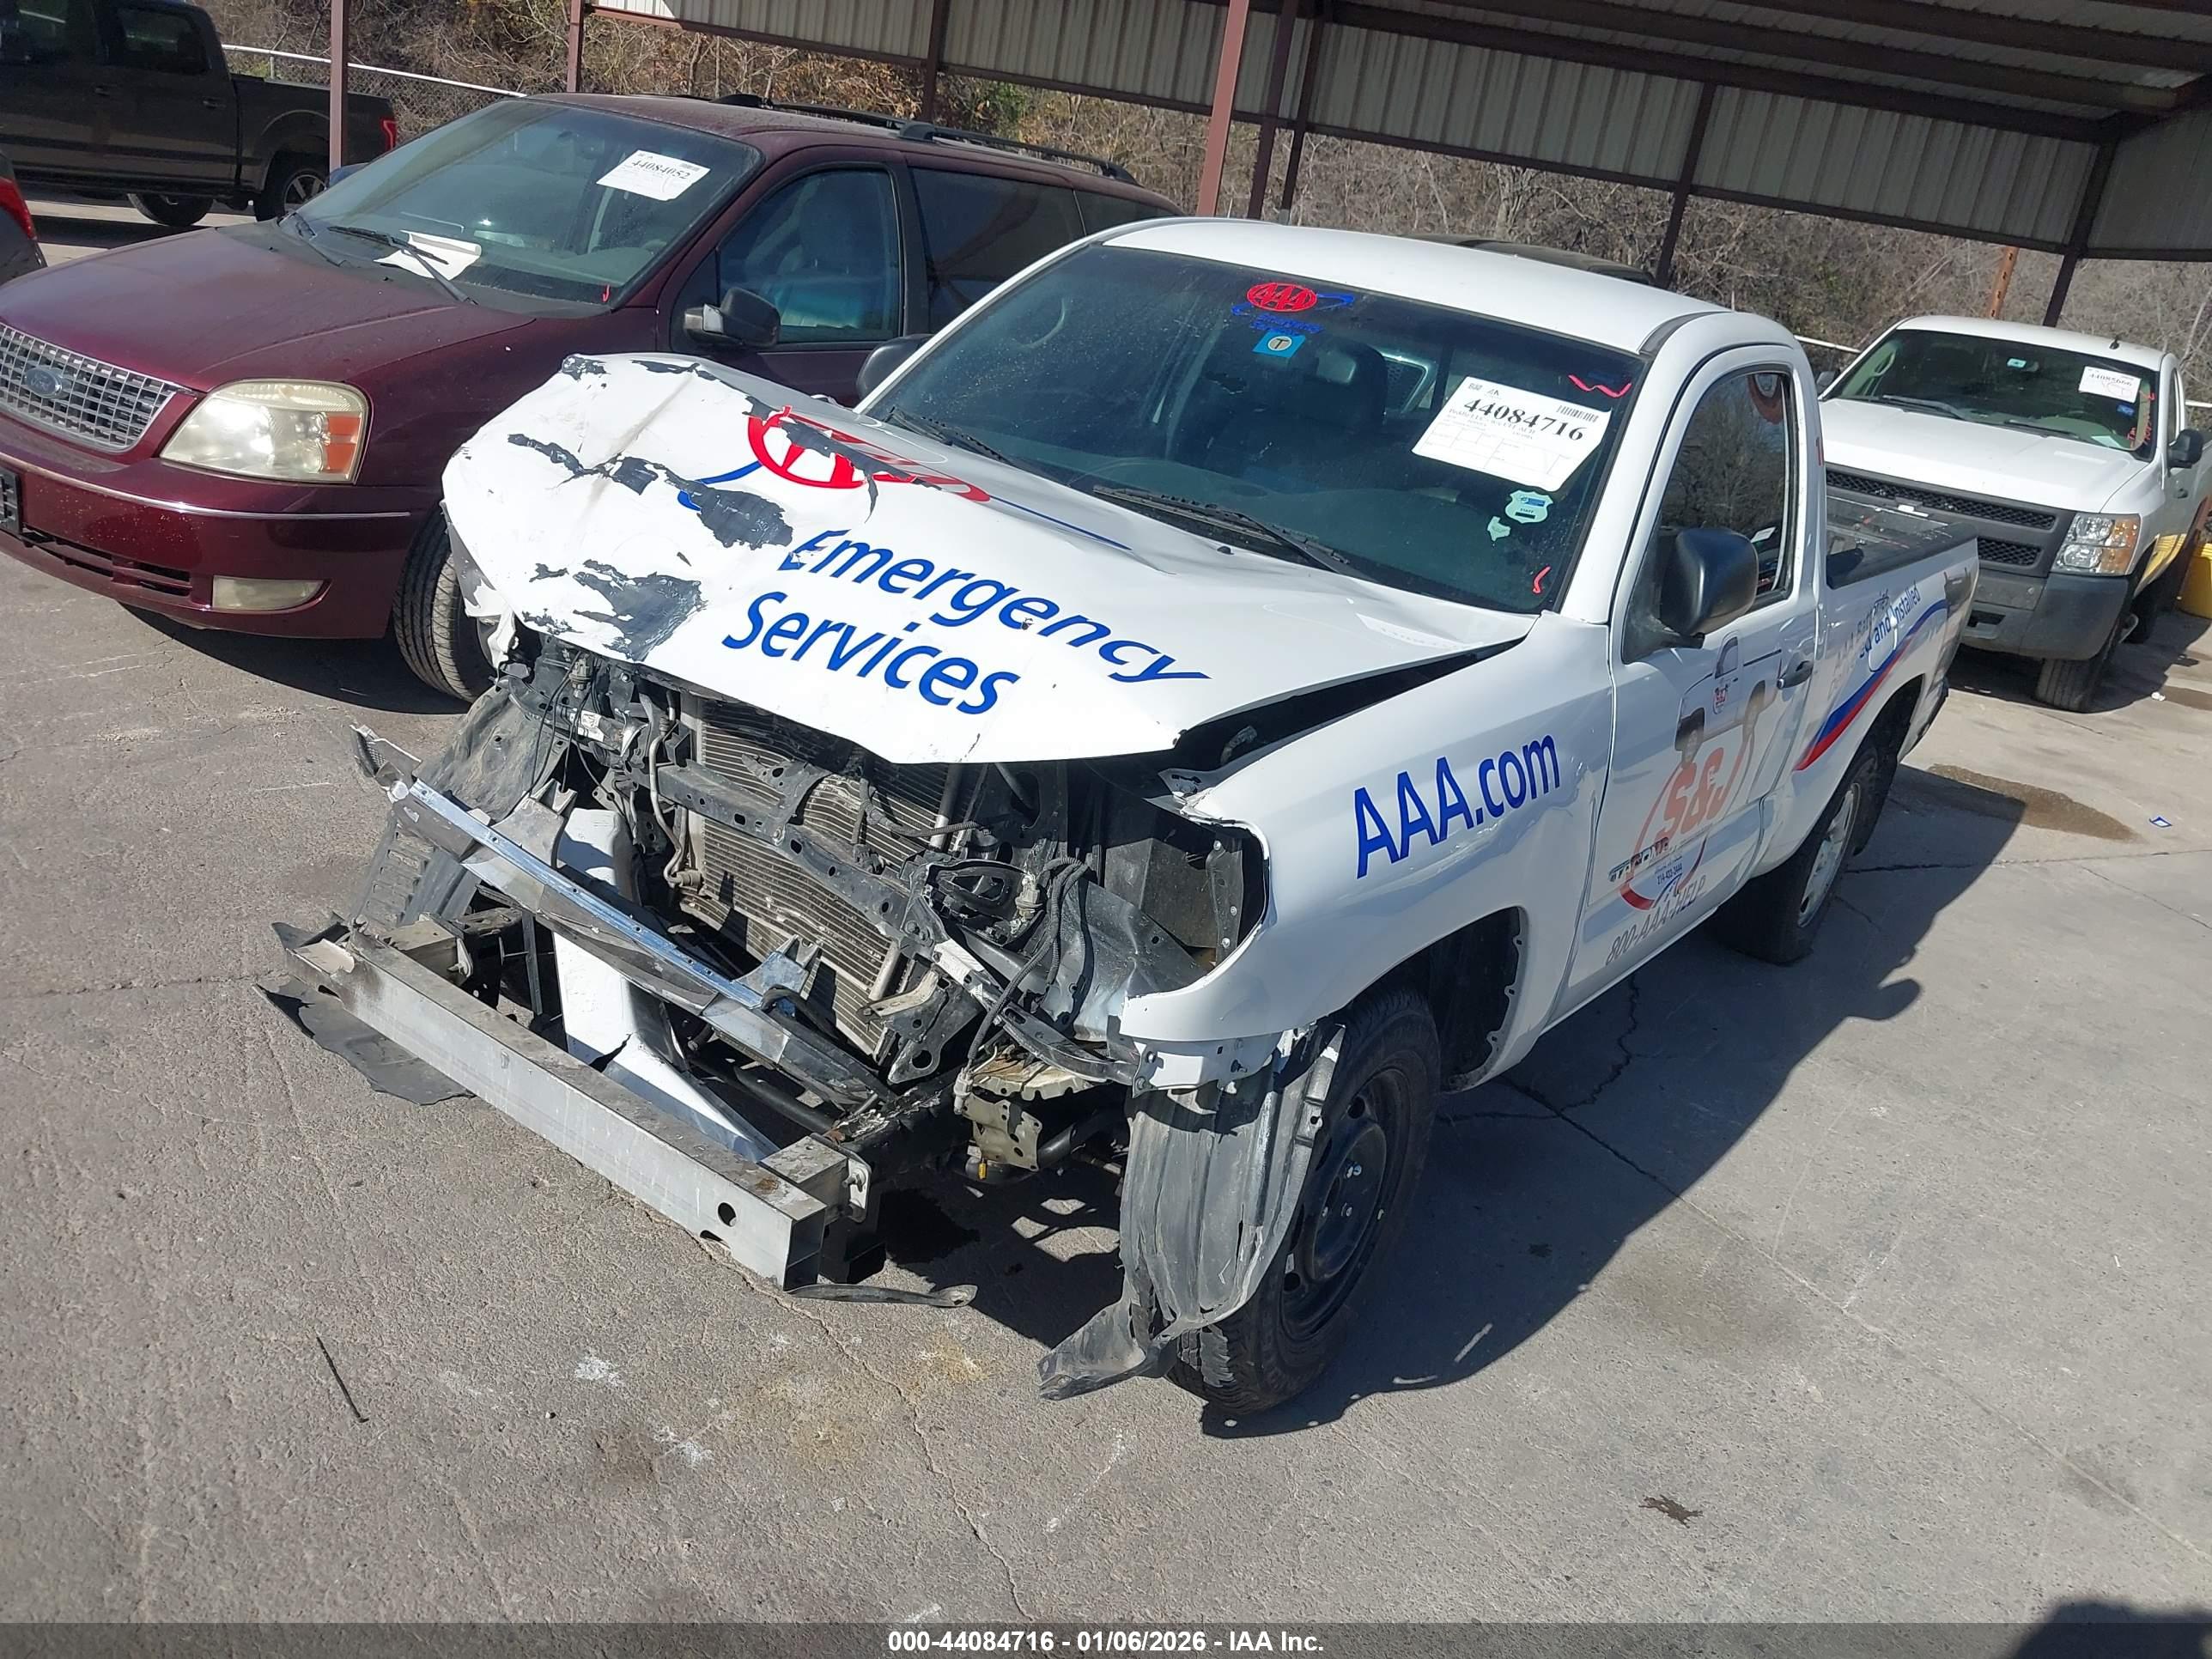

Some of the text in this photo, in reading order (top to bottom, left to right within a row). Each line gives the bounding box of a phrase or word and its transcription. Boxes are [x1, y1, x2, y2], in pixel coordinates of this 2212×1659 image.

[1248, 283, 1316, 312] AAA
[1463, 398, 1589, 441] 44084716
[778, 529, 1212, 684] Emergency
[1875, 609, 1892, 644] and
[721, 591, 1020, 715] Services
[1353, 733, 1561, 880] AAA.com
